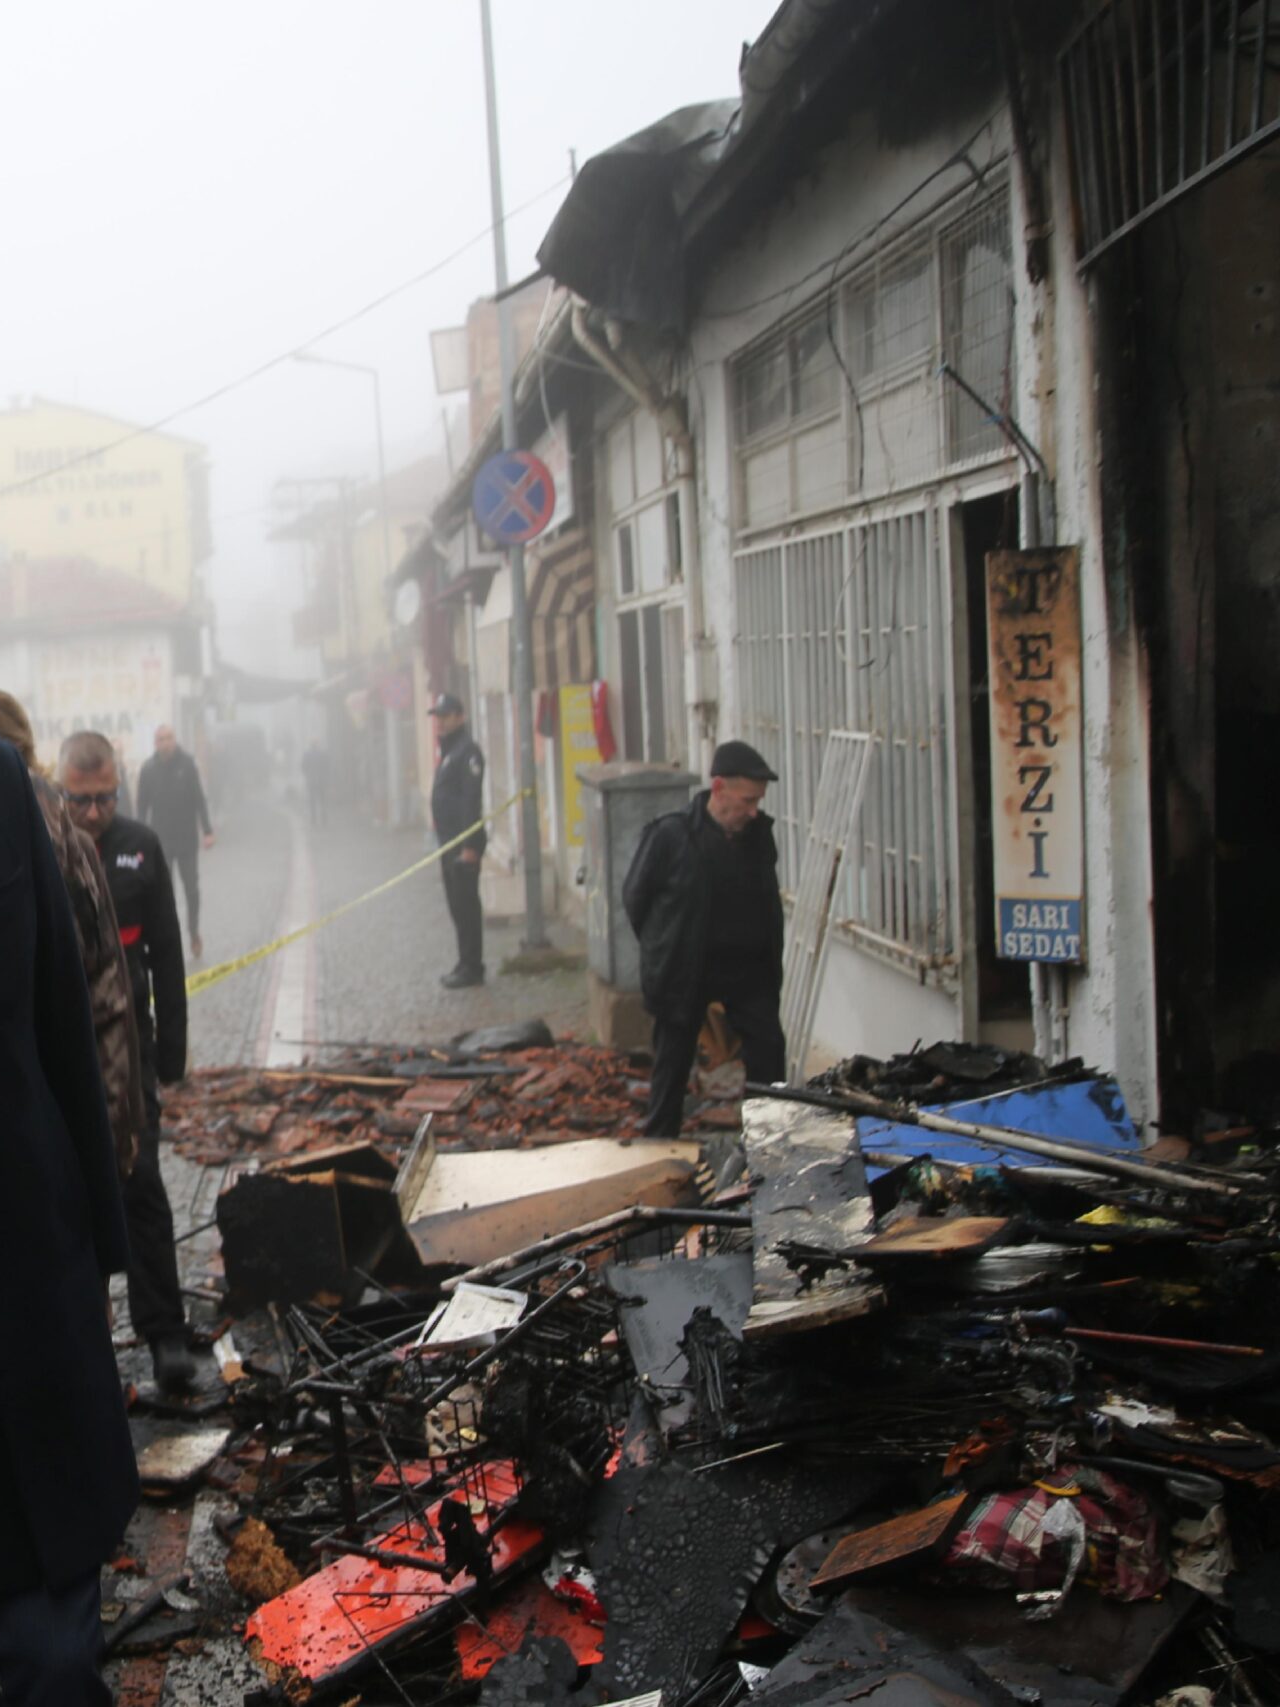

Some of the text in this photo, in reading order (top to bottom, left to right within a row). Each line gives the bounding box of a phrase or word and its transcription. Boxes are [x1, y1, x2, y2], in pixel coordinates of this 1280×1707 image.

[1014, 567, 1060, 879] TERZİ
[1013, 903, 1070, 930] SARI
[1004, 931, 1080, 960] SEDAT
